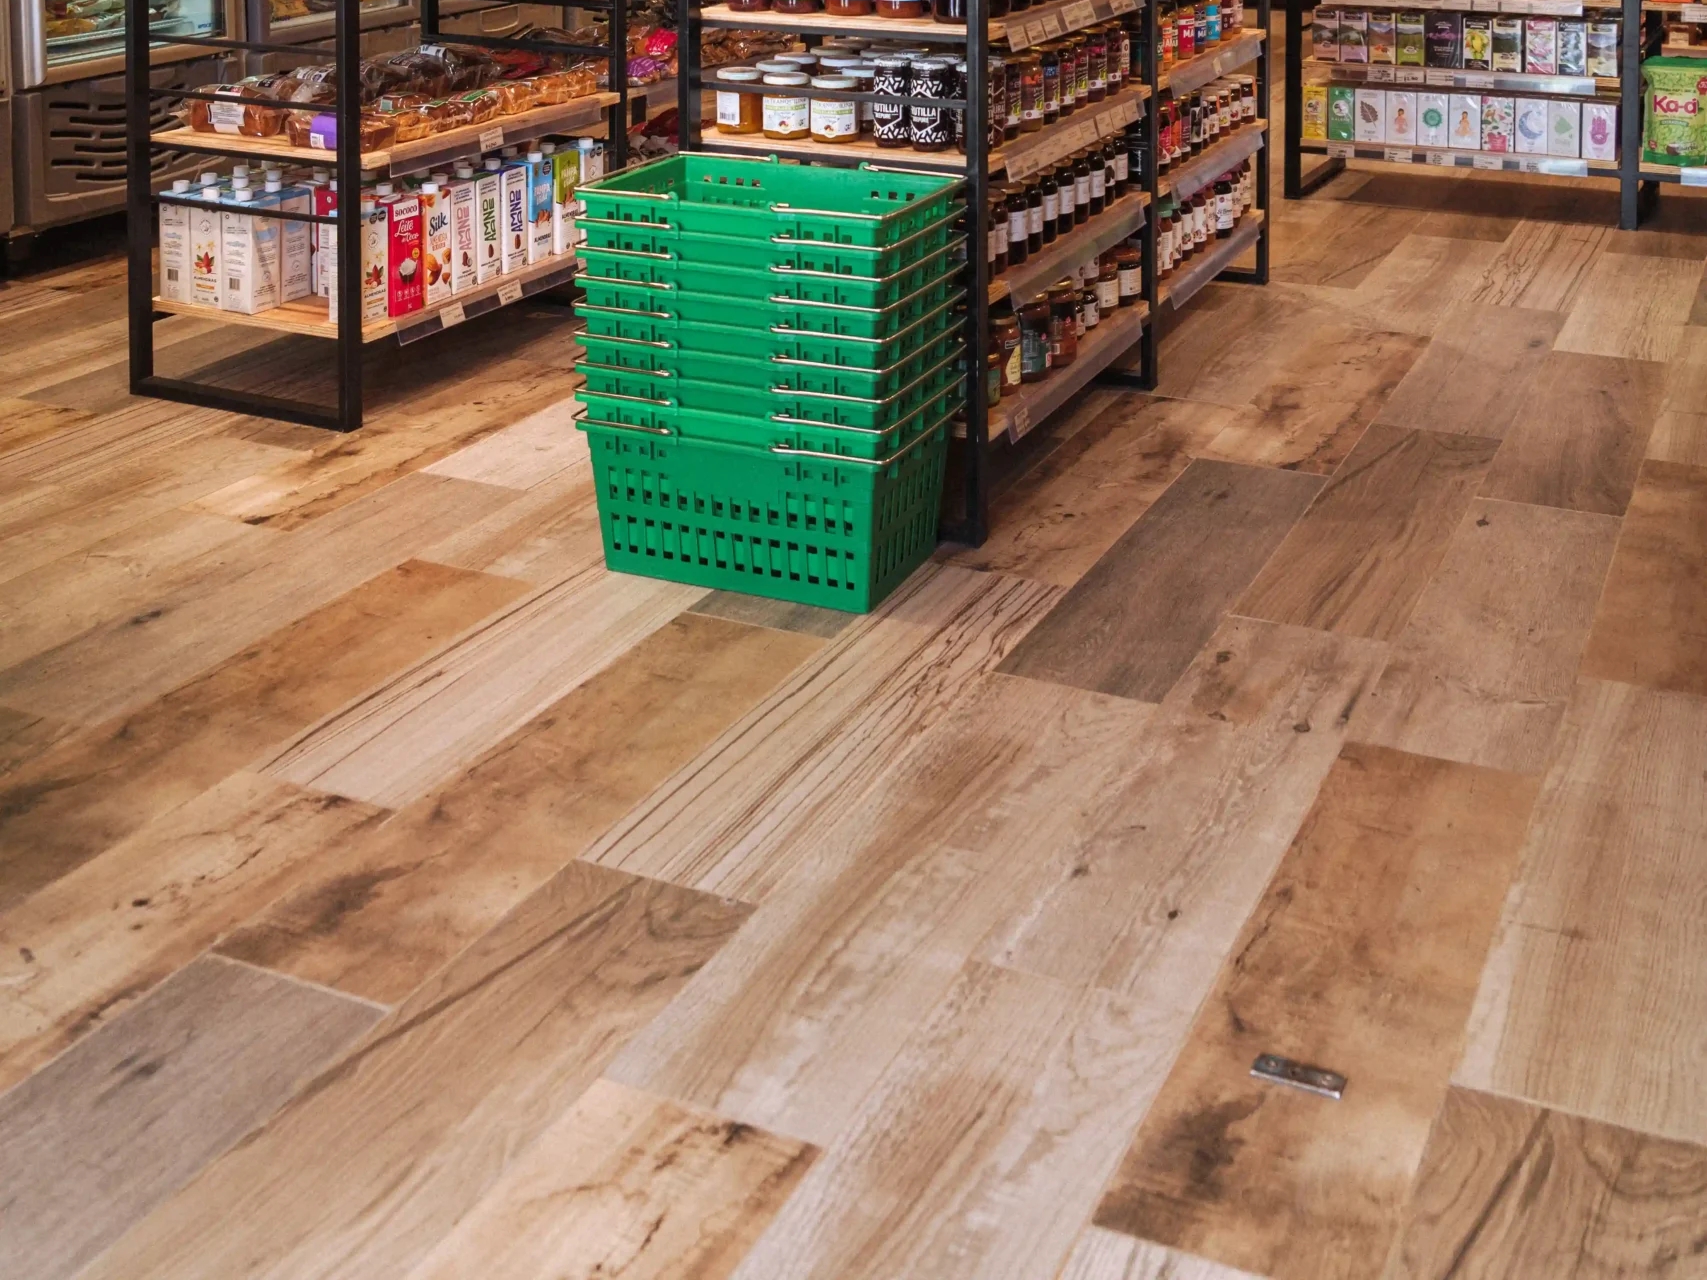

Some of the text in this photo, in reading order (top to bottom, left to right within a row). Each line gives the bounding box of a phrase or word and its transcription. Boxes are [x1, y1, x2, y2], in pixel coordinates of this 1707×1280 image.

[394, 204, 418, 217] SOCOCO
[394, 219, 414, 238] Leite
[428, 212, 449, 237] Silk
